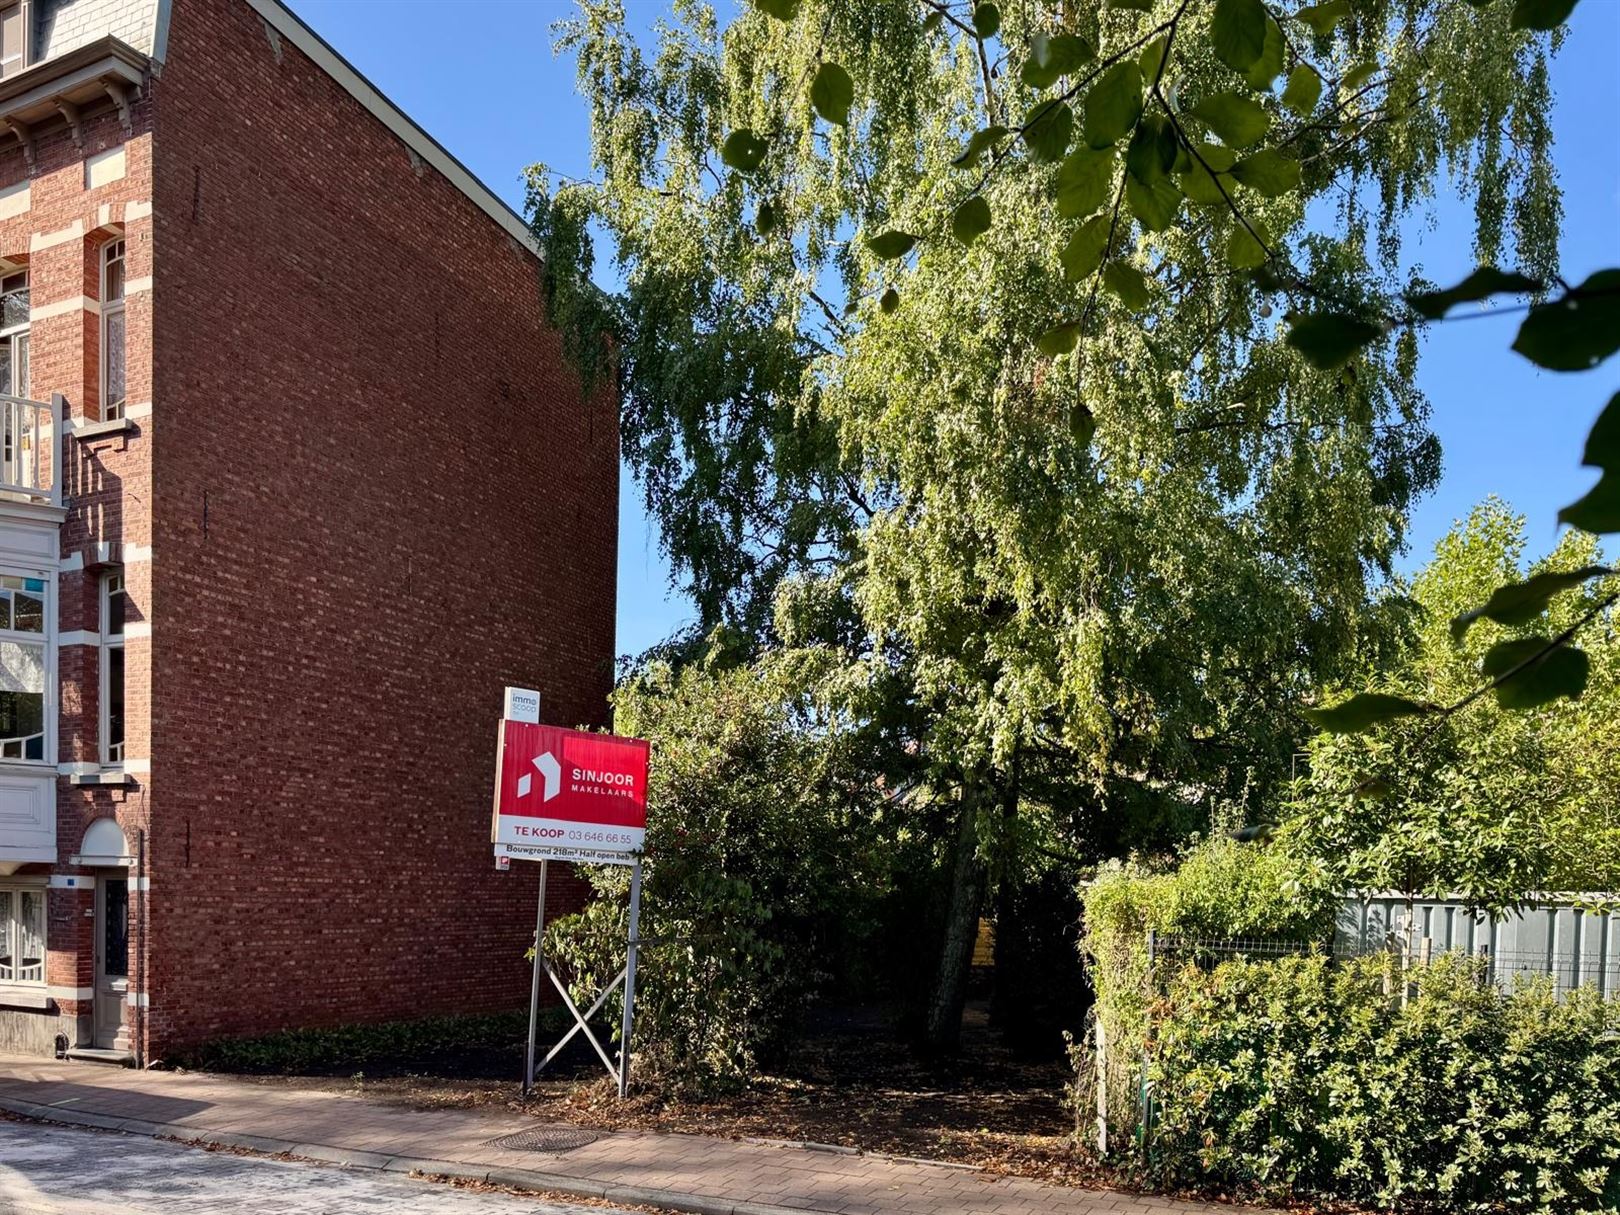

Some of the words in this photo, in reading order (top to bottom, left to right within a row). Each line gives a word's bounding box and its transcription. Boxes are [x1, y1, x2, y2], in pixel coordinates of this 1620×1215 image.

[513, 693, 536, 705] immo
[513, 703, 536, 713] scoop
[572, 768, 634, 786] SINJOOR
[571, 784, 634, 798] MAKELAARS
[514, 825, 529, 836] TE
[532, 826, 565, 839] KOOP
[568, 830, 582, 840] 03
[584, 832, 603, 842] 646
[605, 834, 618, 843] 66
[620, 835, 632, 844] 55
[506, 844, 551, 855] Bouwgrond
[579, 849, 596, 858] Half
